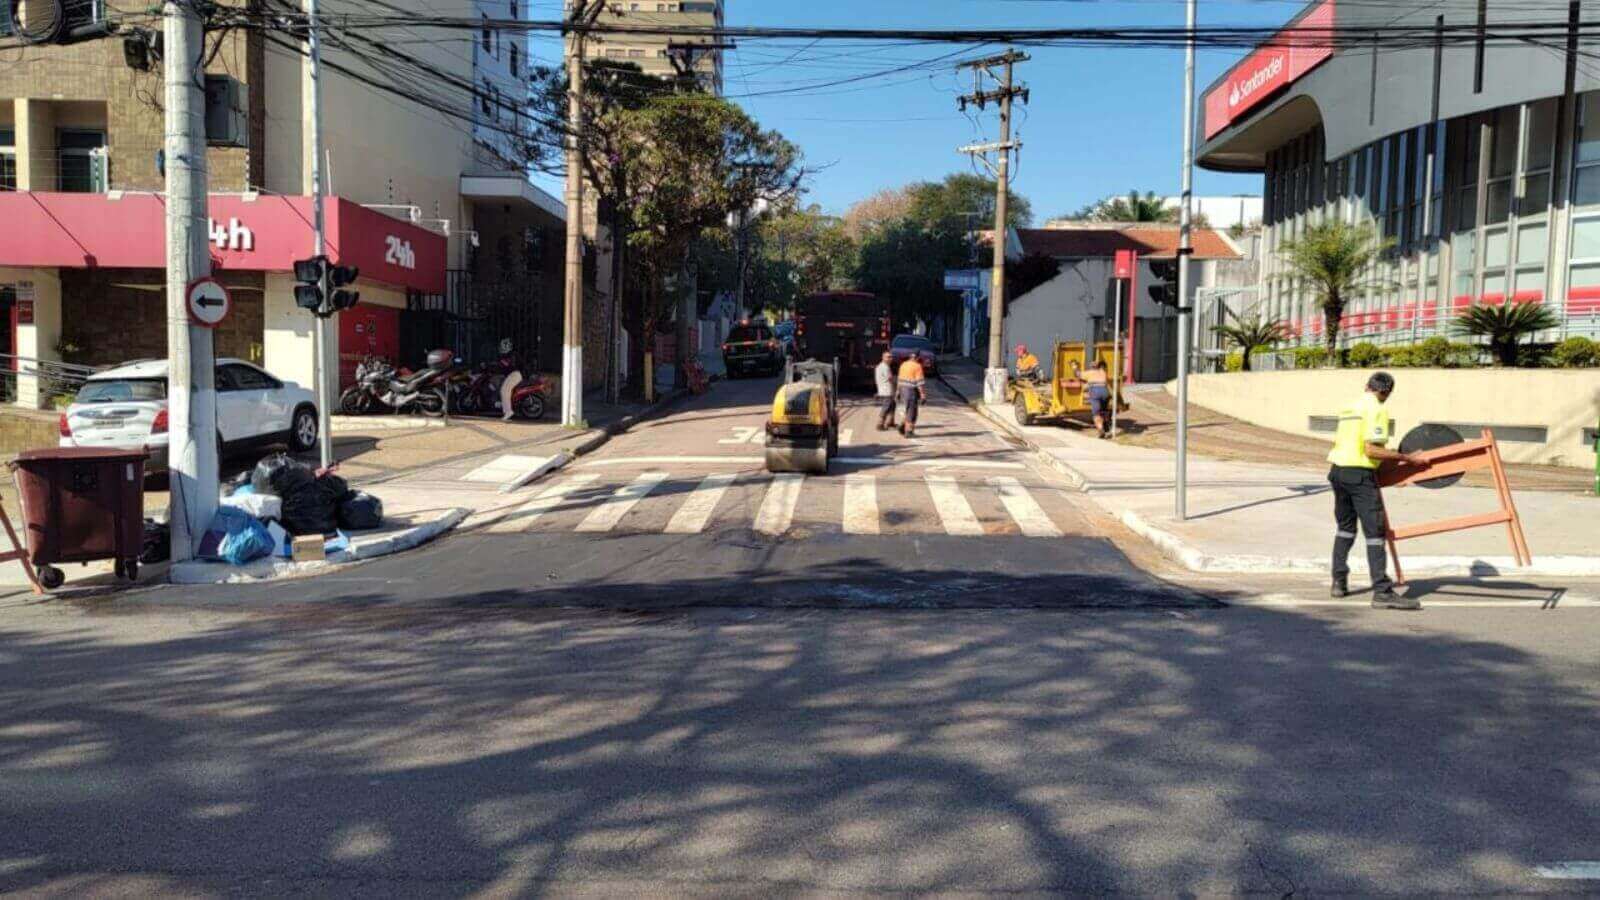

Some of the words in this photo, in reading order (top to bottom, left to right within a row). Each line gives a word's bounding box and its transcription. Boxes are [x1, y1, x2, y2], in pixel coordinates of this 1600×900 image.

[1240, 54, 1284, 100] Santander
[208, 216, 252, 250] 4h
[385, 235, 416, 269] 24h
